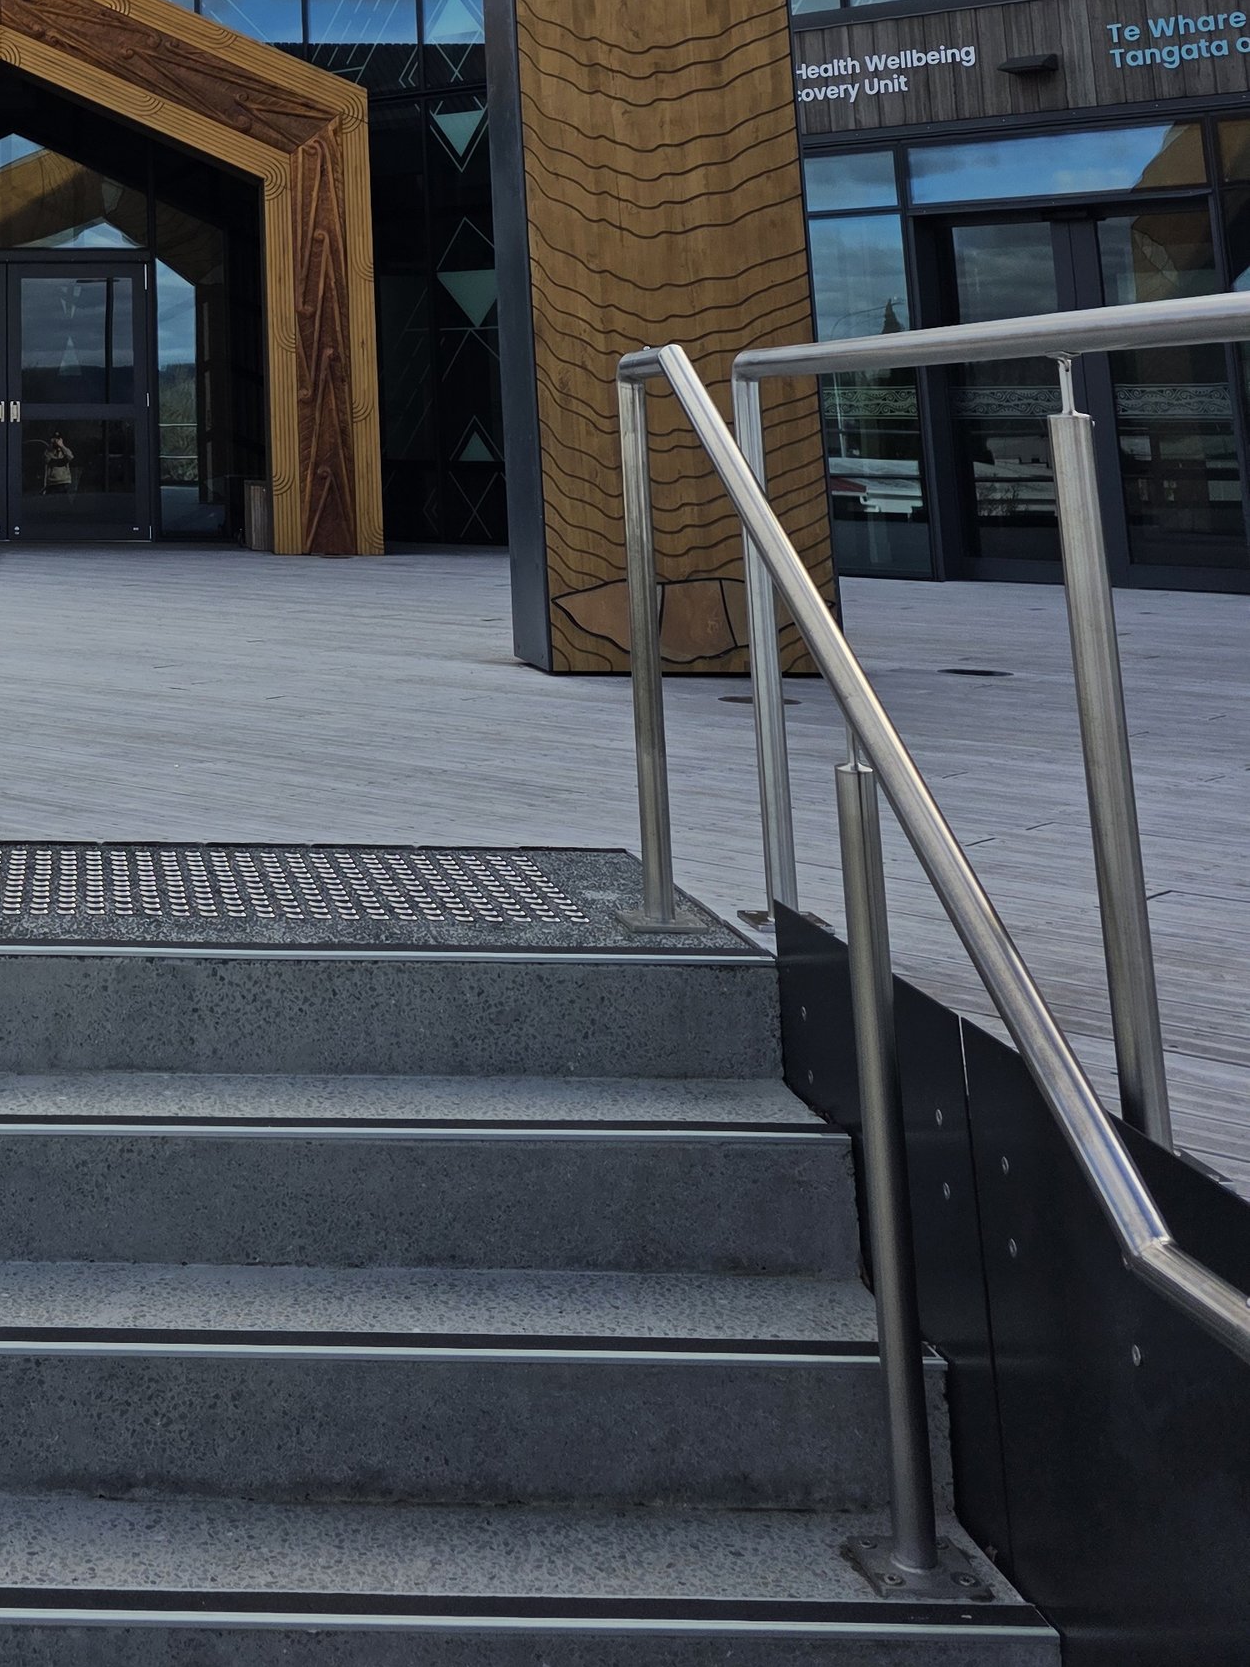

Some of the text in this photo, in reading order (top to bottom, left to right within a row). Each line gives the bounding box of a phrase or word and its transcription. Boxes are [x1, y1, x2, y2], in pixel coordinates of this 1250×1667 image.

[1106, 11, 1247, 43] Te Whare
[864, 44, 976, 67] Wellbeing
[1109, 38, 1229, 69] Tangata
[797, 73, 908, 103] overy Unit
